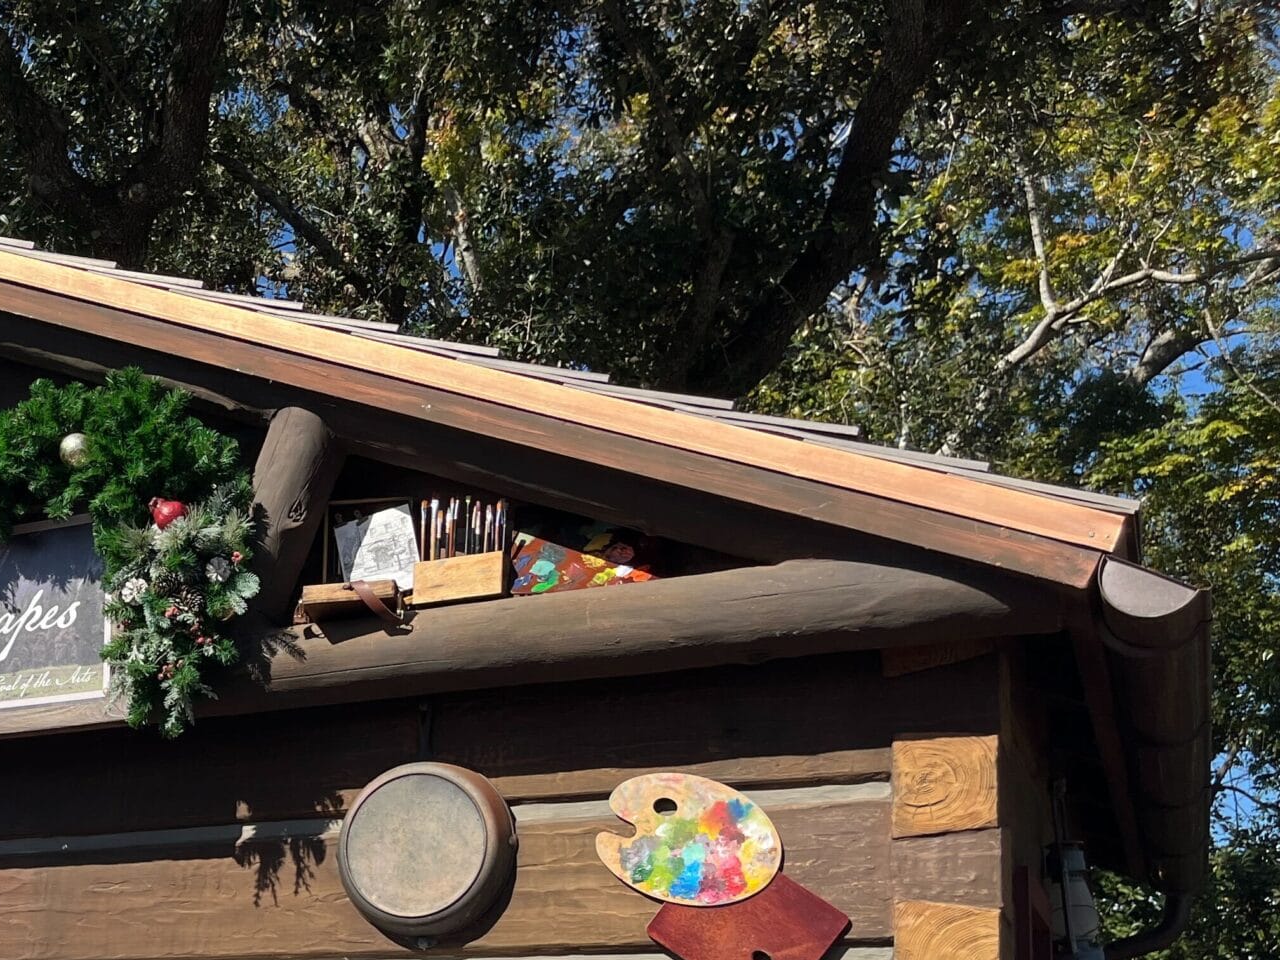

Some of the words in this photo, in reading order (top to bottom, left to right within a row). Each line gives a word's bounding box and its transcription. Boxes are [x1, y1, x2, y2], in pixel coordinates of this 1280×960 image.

[19, 676, 33, 697] of
[33, 670, 51, 688] the
[55, 666, 97, 686] Arts
